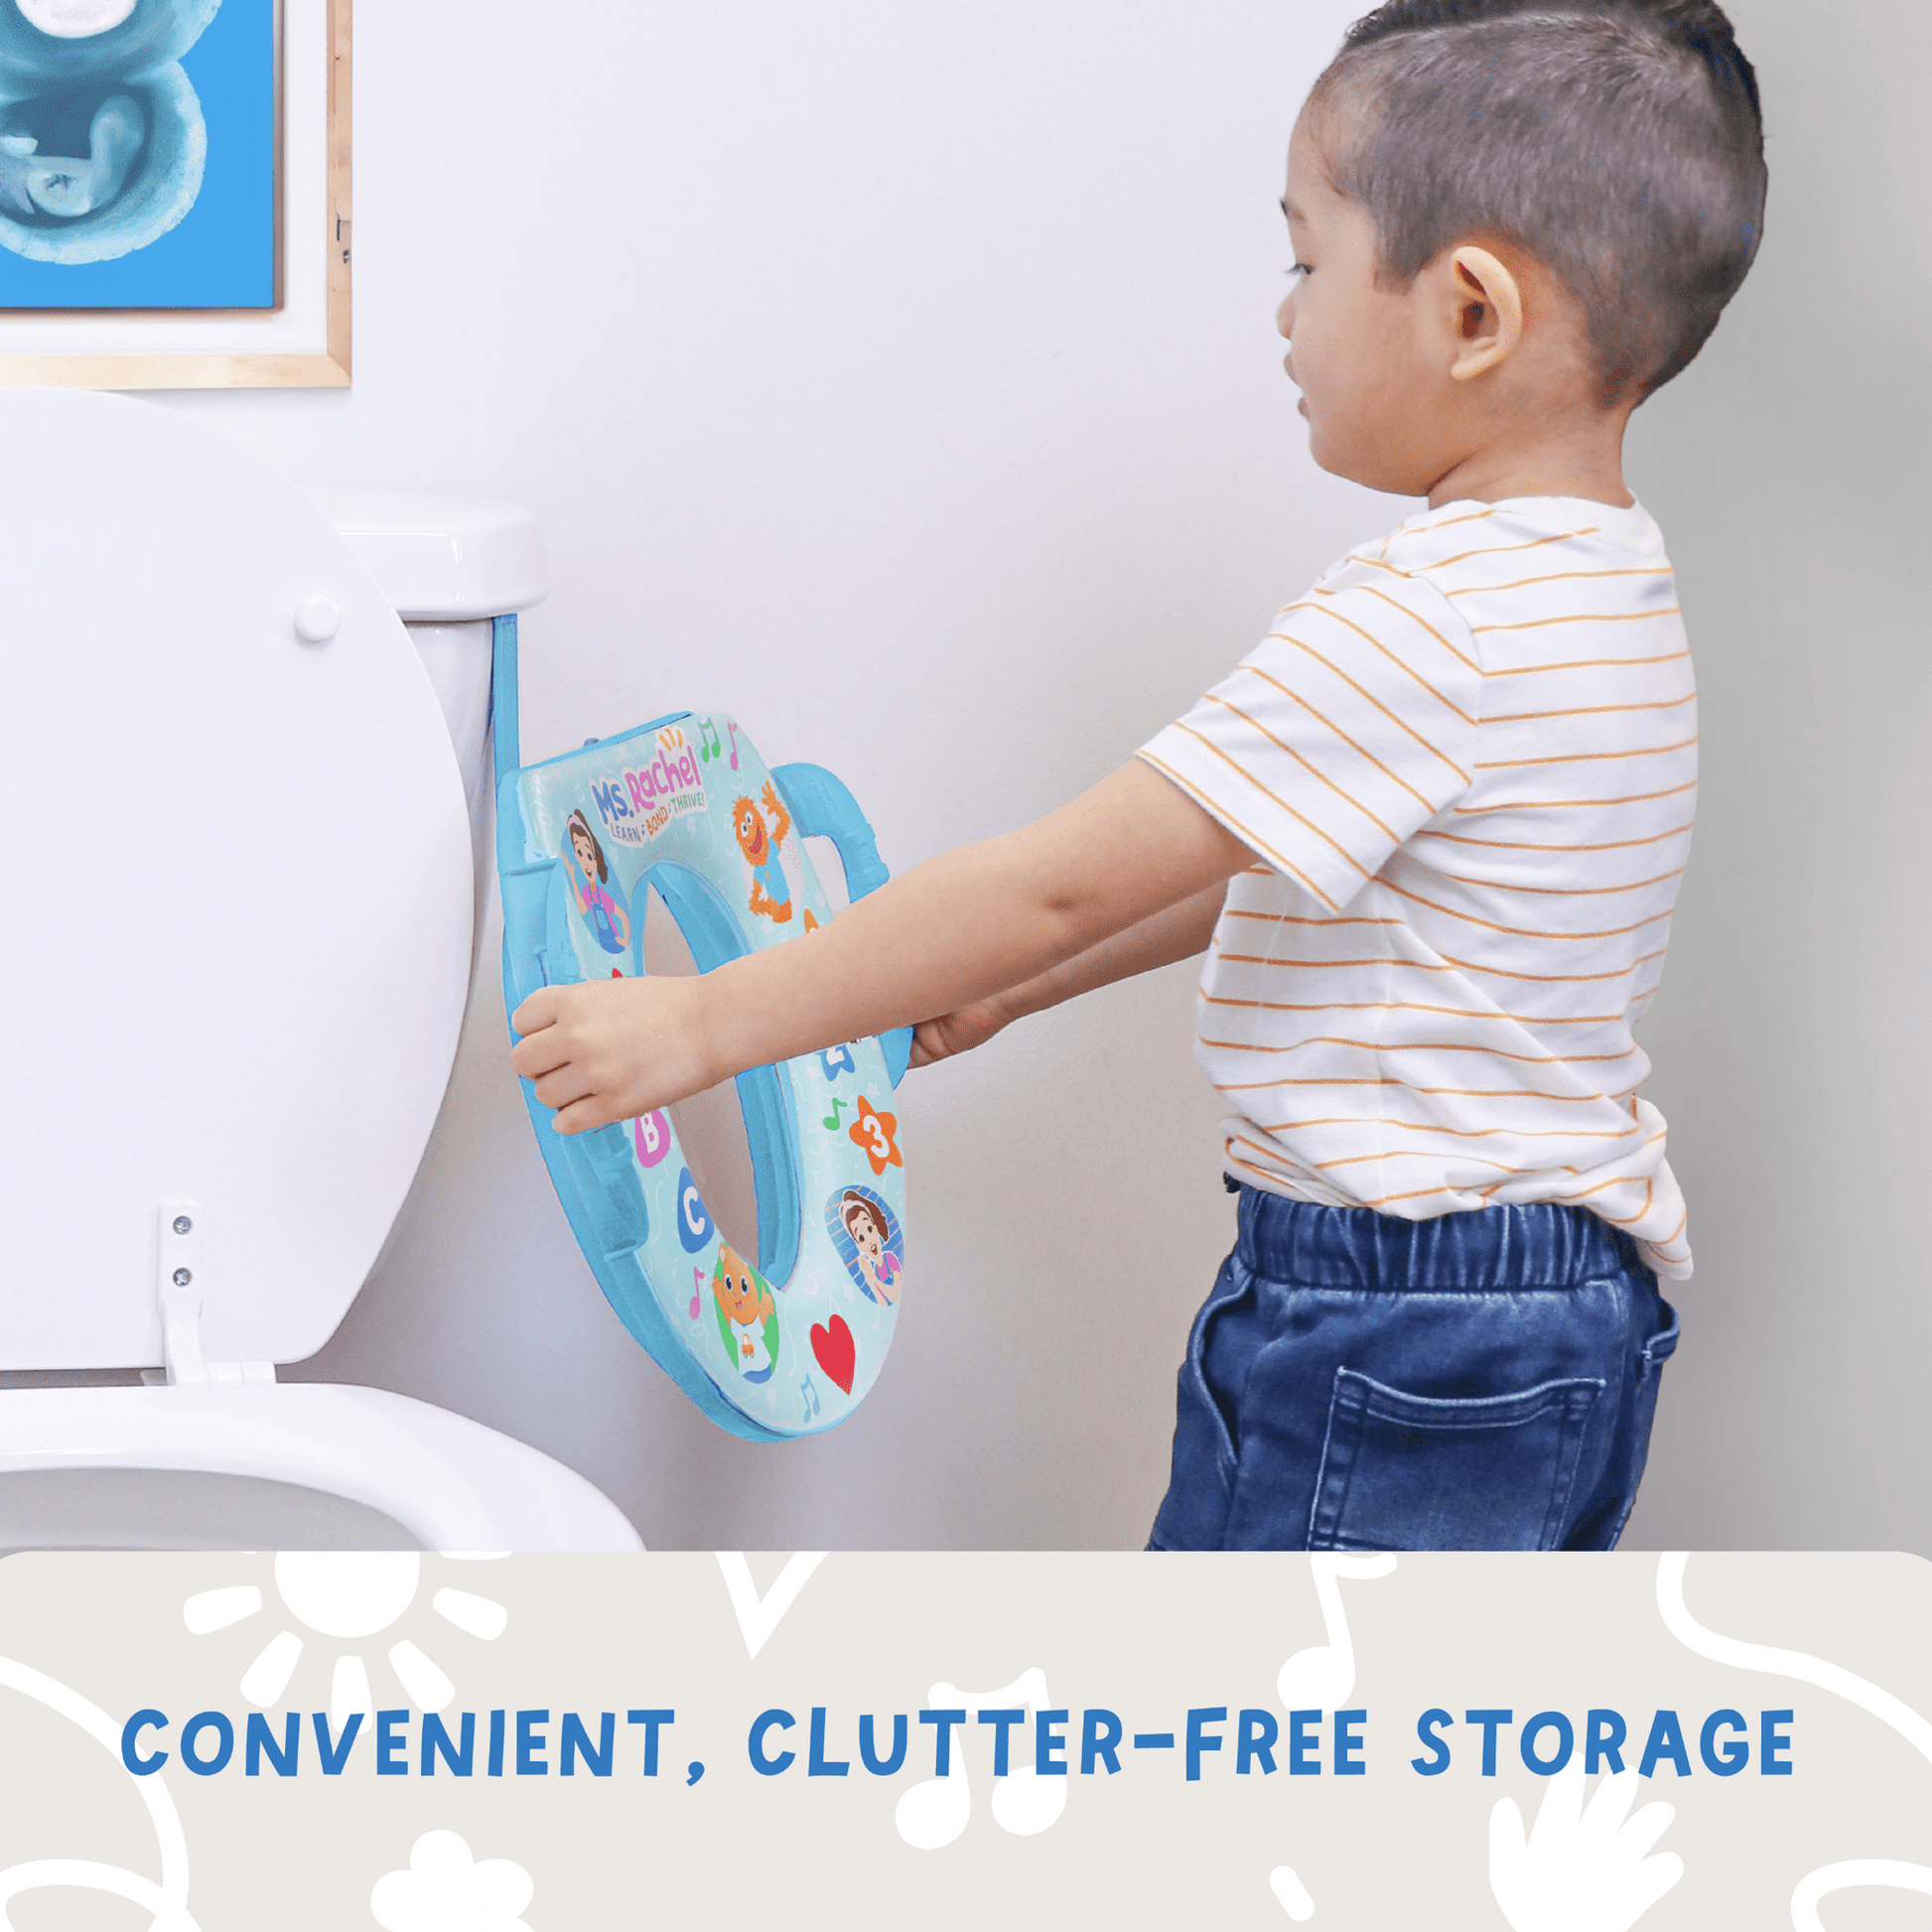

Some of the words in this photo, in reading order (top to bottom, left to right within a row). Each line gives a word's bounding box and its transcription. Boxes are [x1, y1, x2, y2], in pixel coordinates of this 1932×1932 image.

[624, 745, 702, 813] Rachel
[611, 822, 642, 843] LEARN
[645, 805, 669, 836] BOND
[670, 791, 706, 814] THRIVE!
[638, 1112, 660, 1154] B
[862, 1114, 891, 1159] 3
[683, 1185, 706, 1236] C
